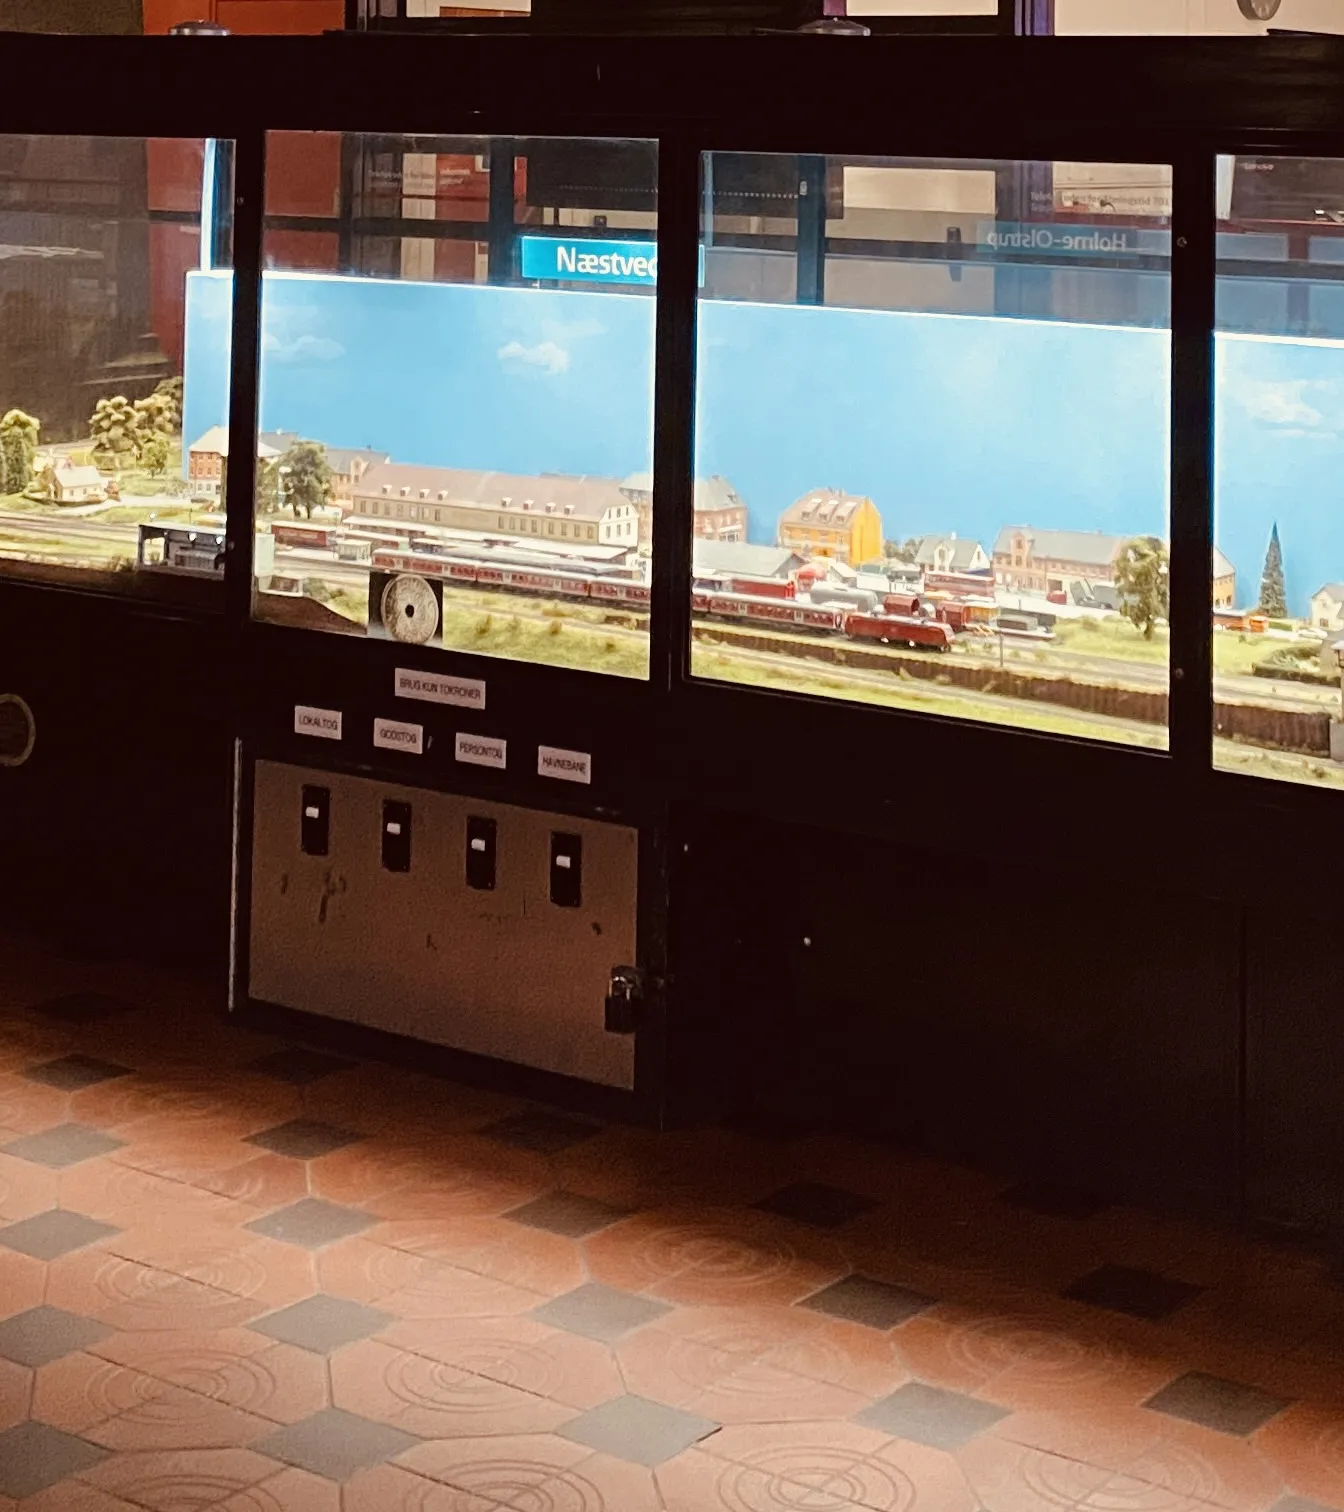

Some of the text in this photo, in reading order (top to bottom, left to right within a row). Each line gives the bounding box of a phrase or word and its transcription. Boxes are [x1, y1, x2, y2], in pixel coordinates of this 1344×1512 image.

[399, 678, 482, 700] BRUG KUN TOKRONER
[299, 715, 338, 730] LOKALTOG
[380, 728, 417, 744] GODSTOG
[459, 741, 502, 759] PERSONTOG
[542, 756, 586, 773] HAVNEBANE
